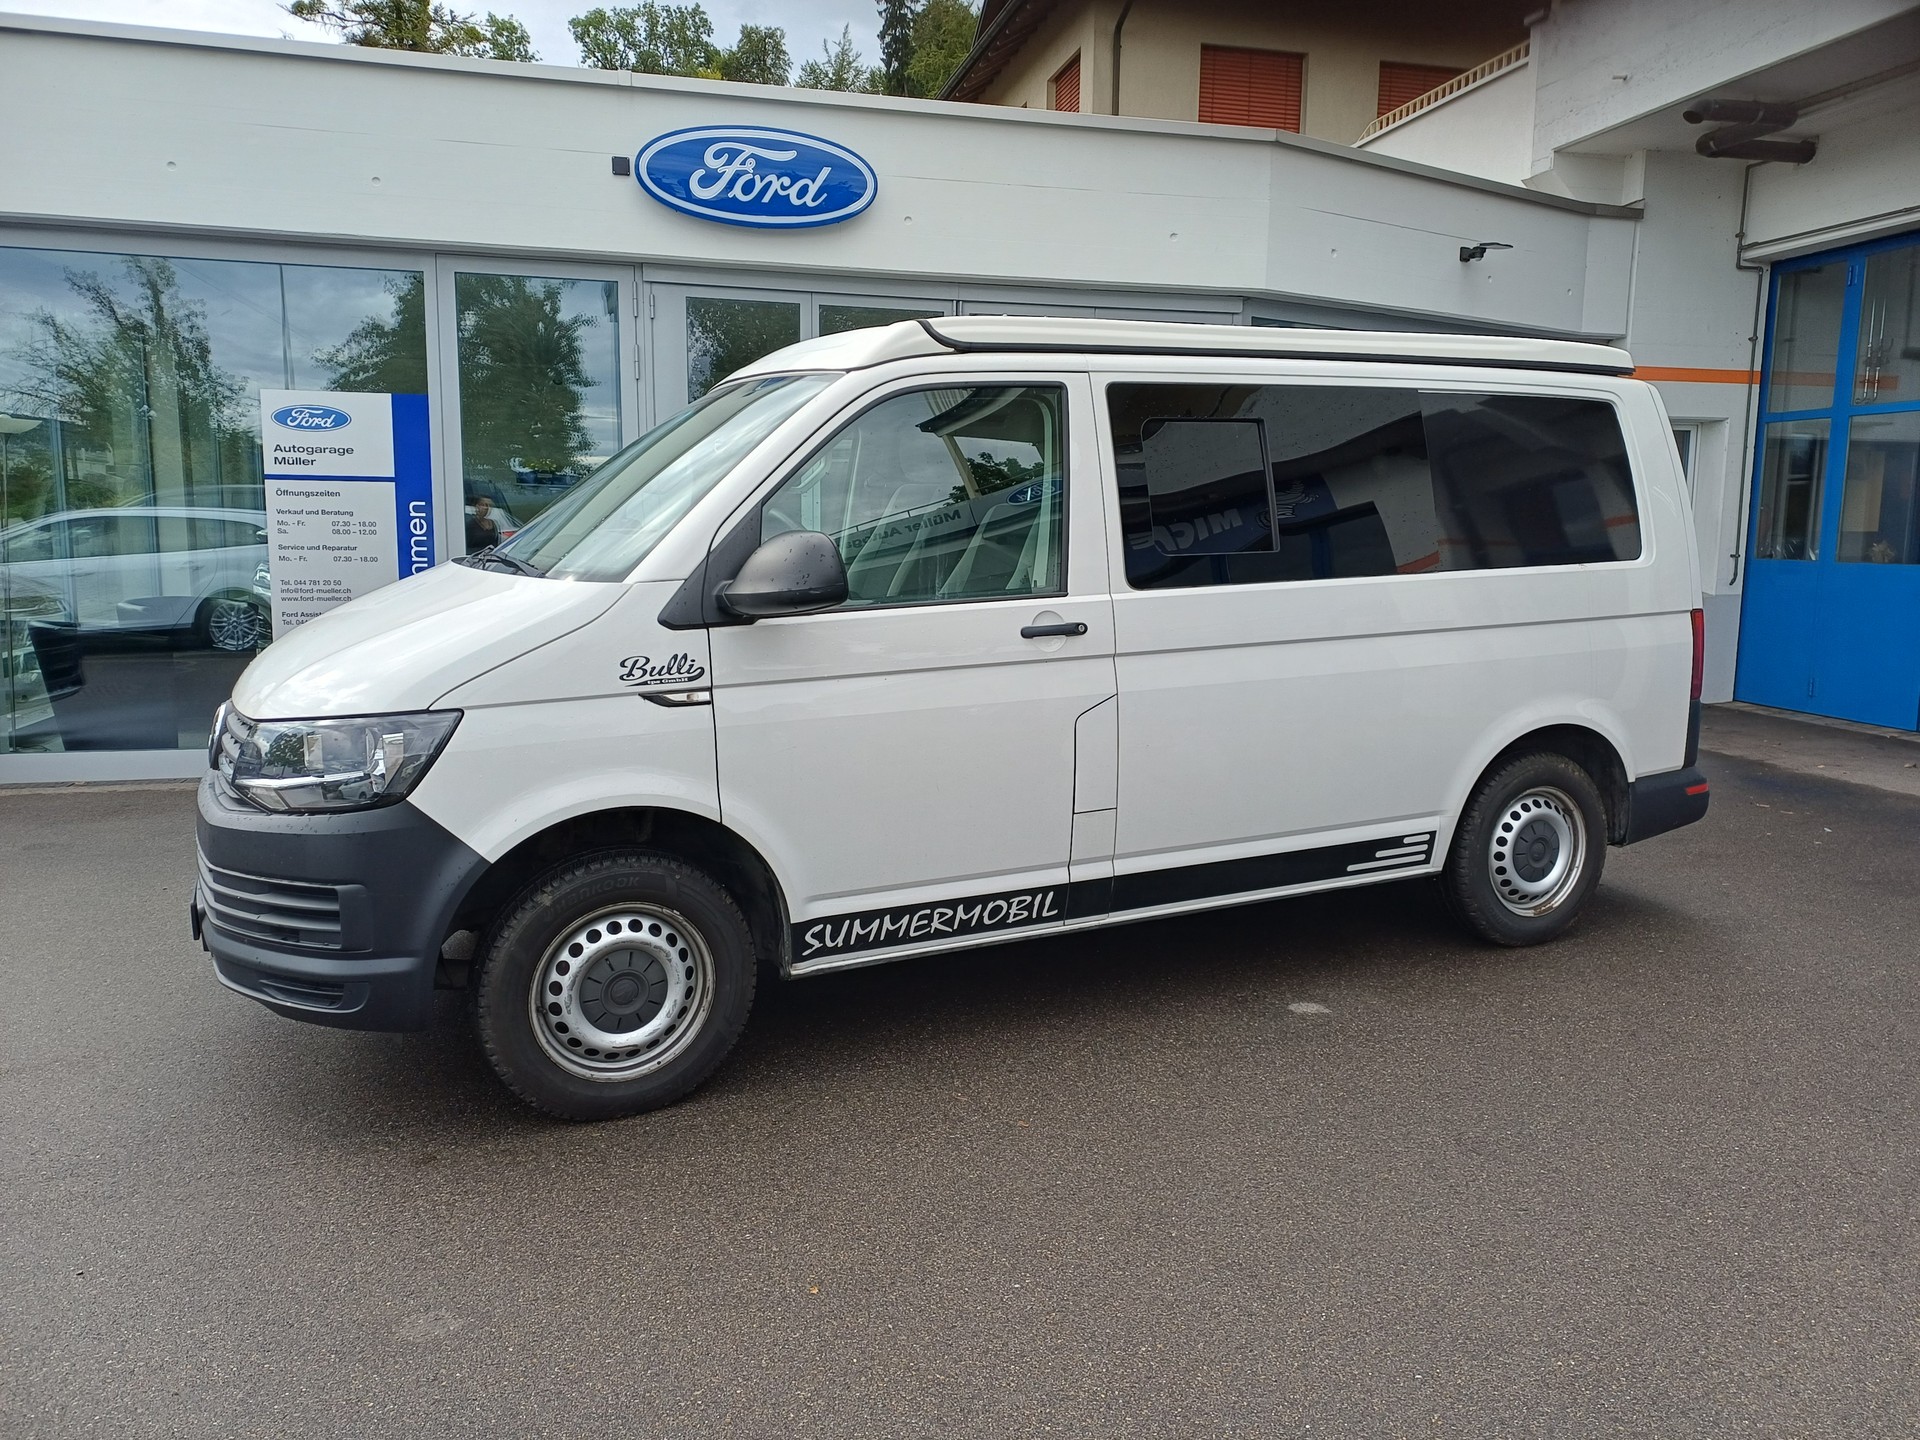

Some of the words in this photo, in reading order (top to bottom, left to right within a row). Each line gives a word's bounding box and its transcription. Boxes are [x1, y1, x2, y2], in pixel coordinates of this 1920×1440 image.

[689, 141, 832, 208] Ford
[286, 408, 336, 428] Ford
[273, 444, 354, 456] Autogarage
[273, 456, 317, 466] Müller
[275, 488, 341, 498] Öffnungszeiten
[321, 509, 354, 517] Beratung
[331, 528, 351, 536] 08.00
[619, 653, 705, 682] Bulli
[802, 891, 1059, 956] SUMMERMOBIL
